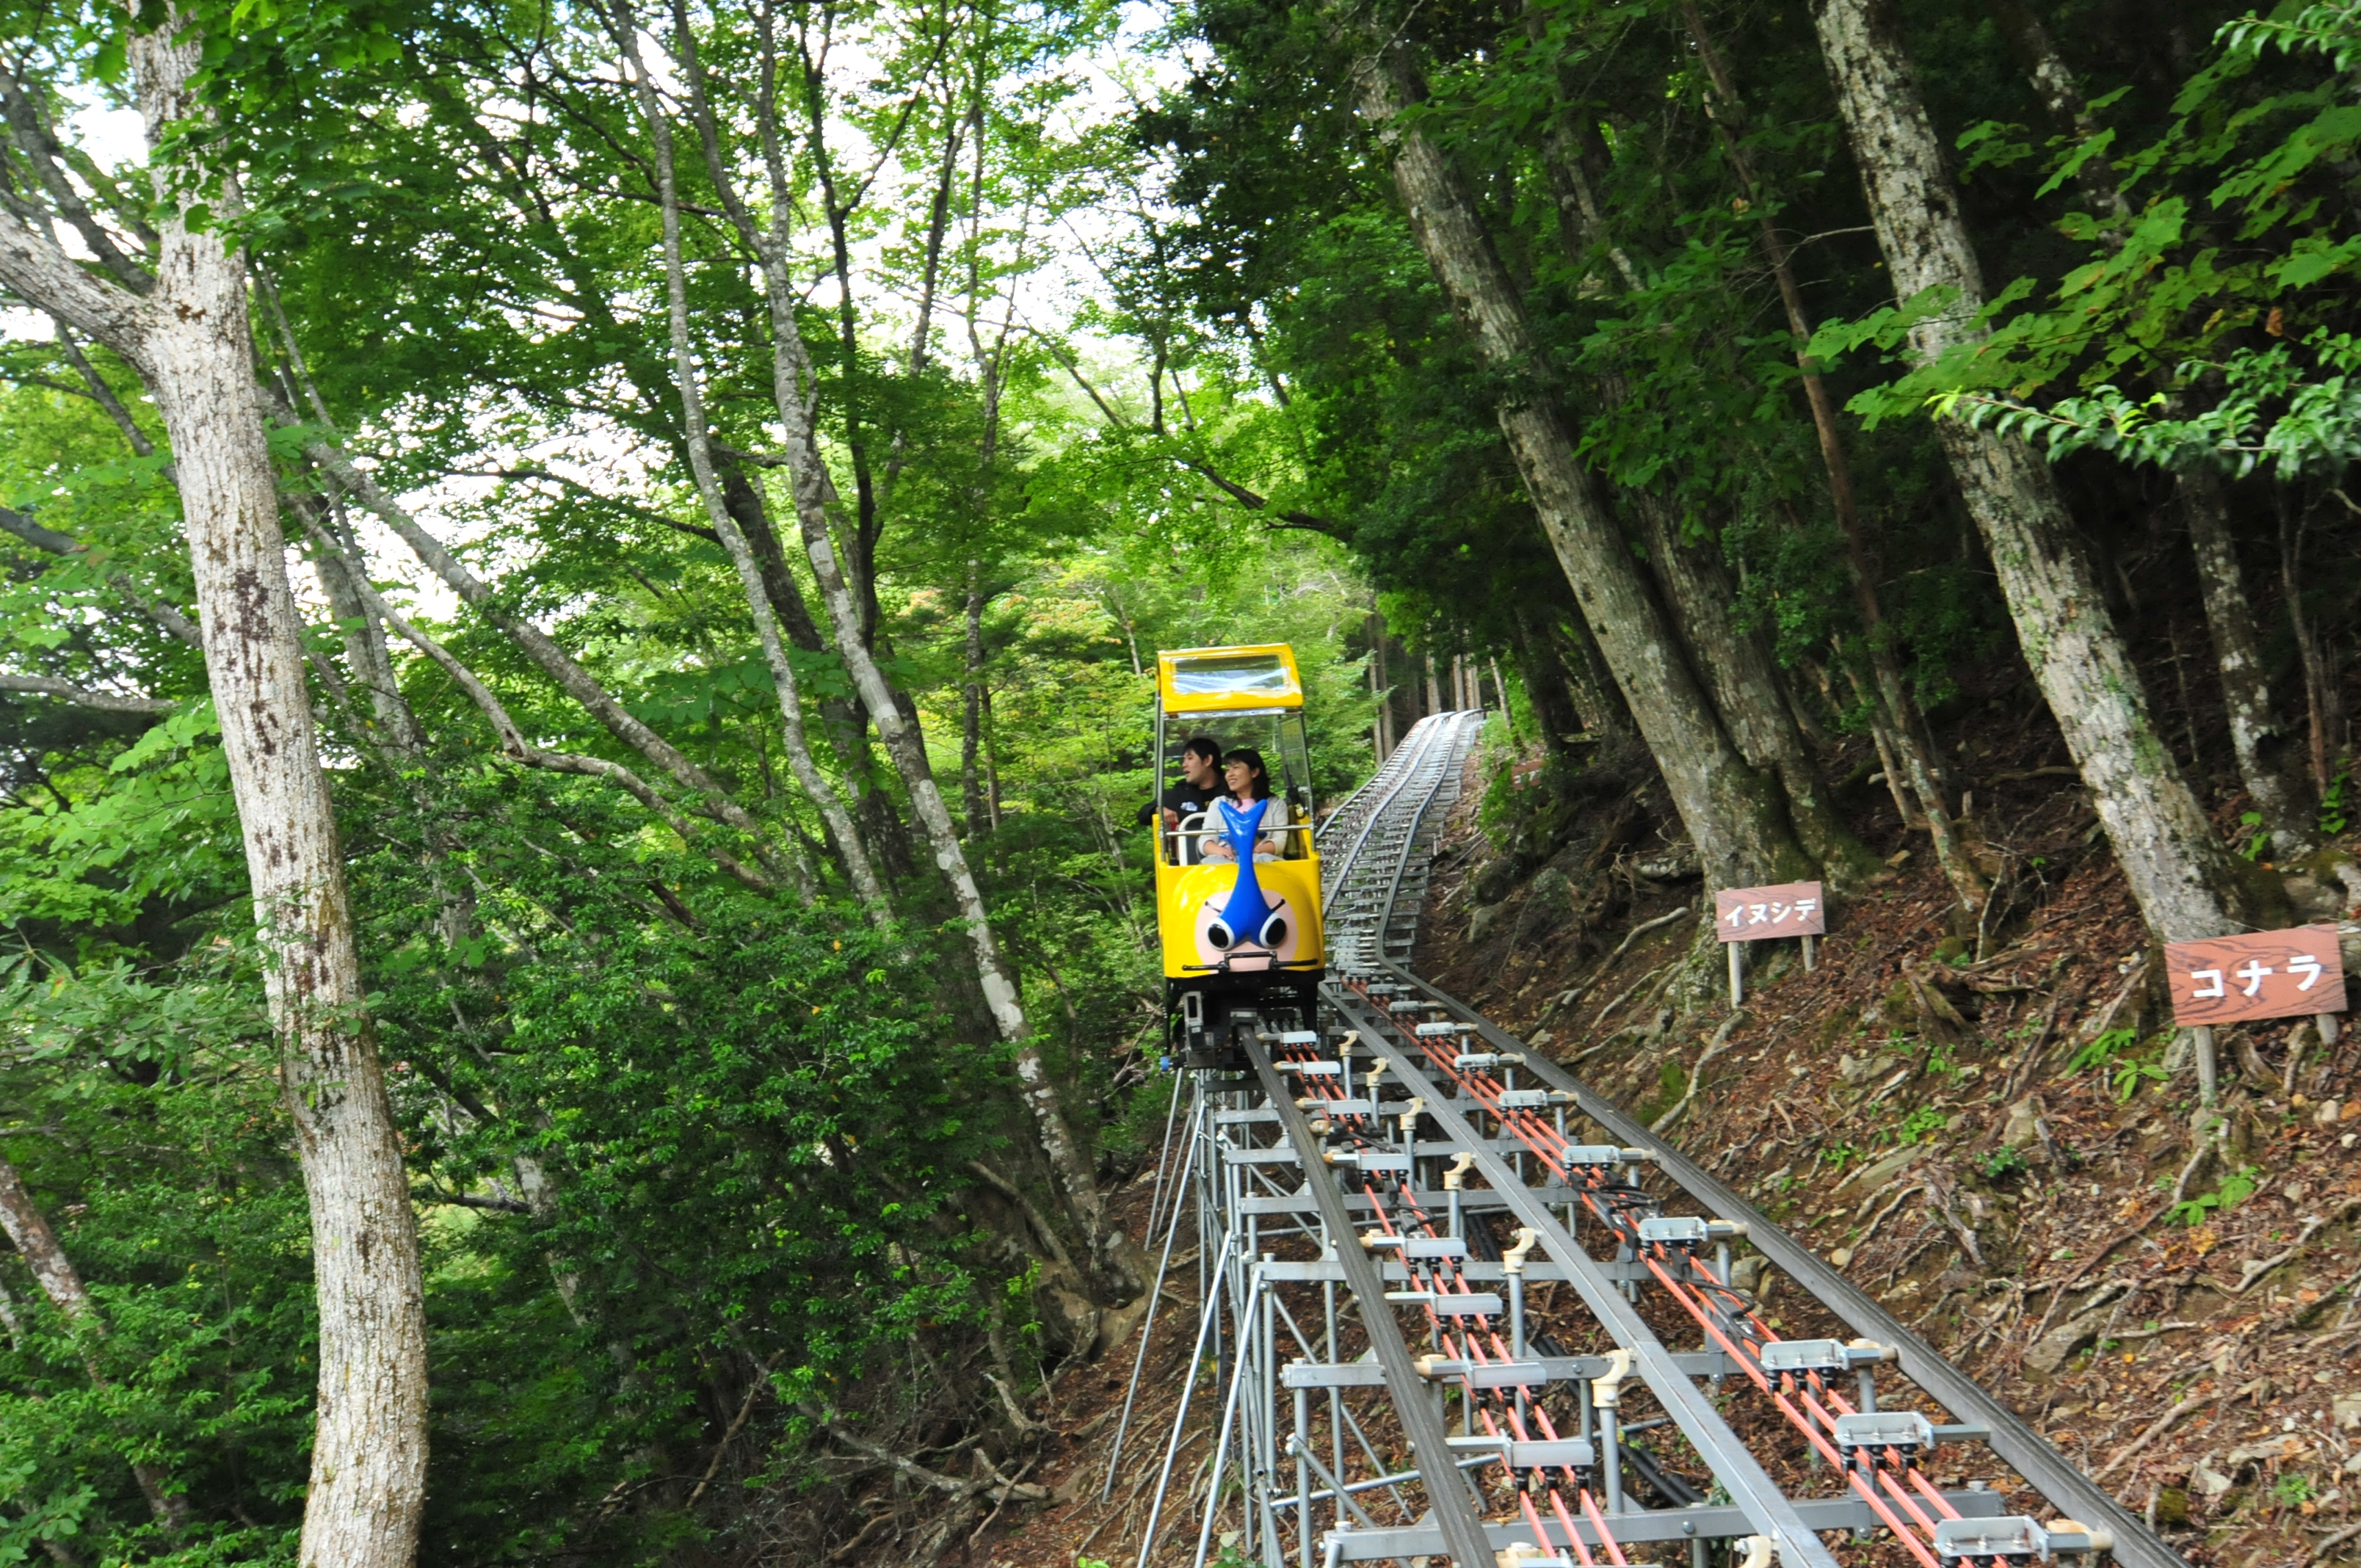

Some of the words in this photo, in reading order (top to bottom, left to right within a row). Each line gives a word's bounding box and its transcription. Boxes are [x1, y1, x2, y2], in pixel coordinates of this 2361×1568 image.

[1724, 898, 1817, 927] イヌシデ
[2191, 955, 2321, 997] コナラ
